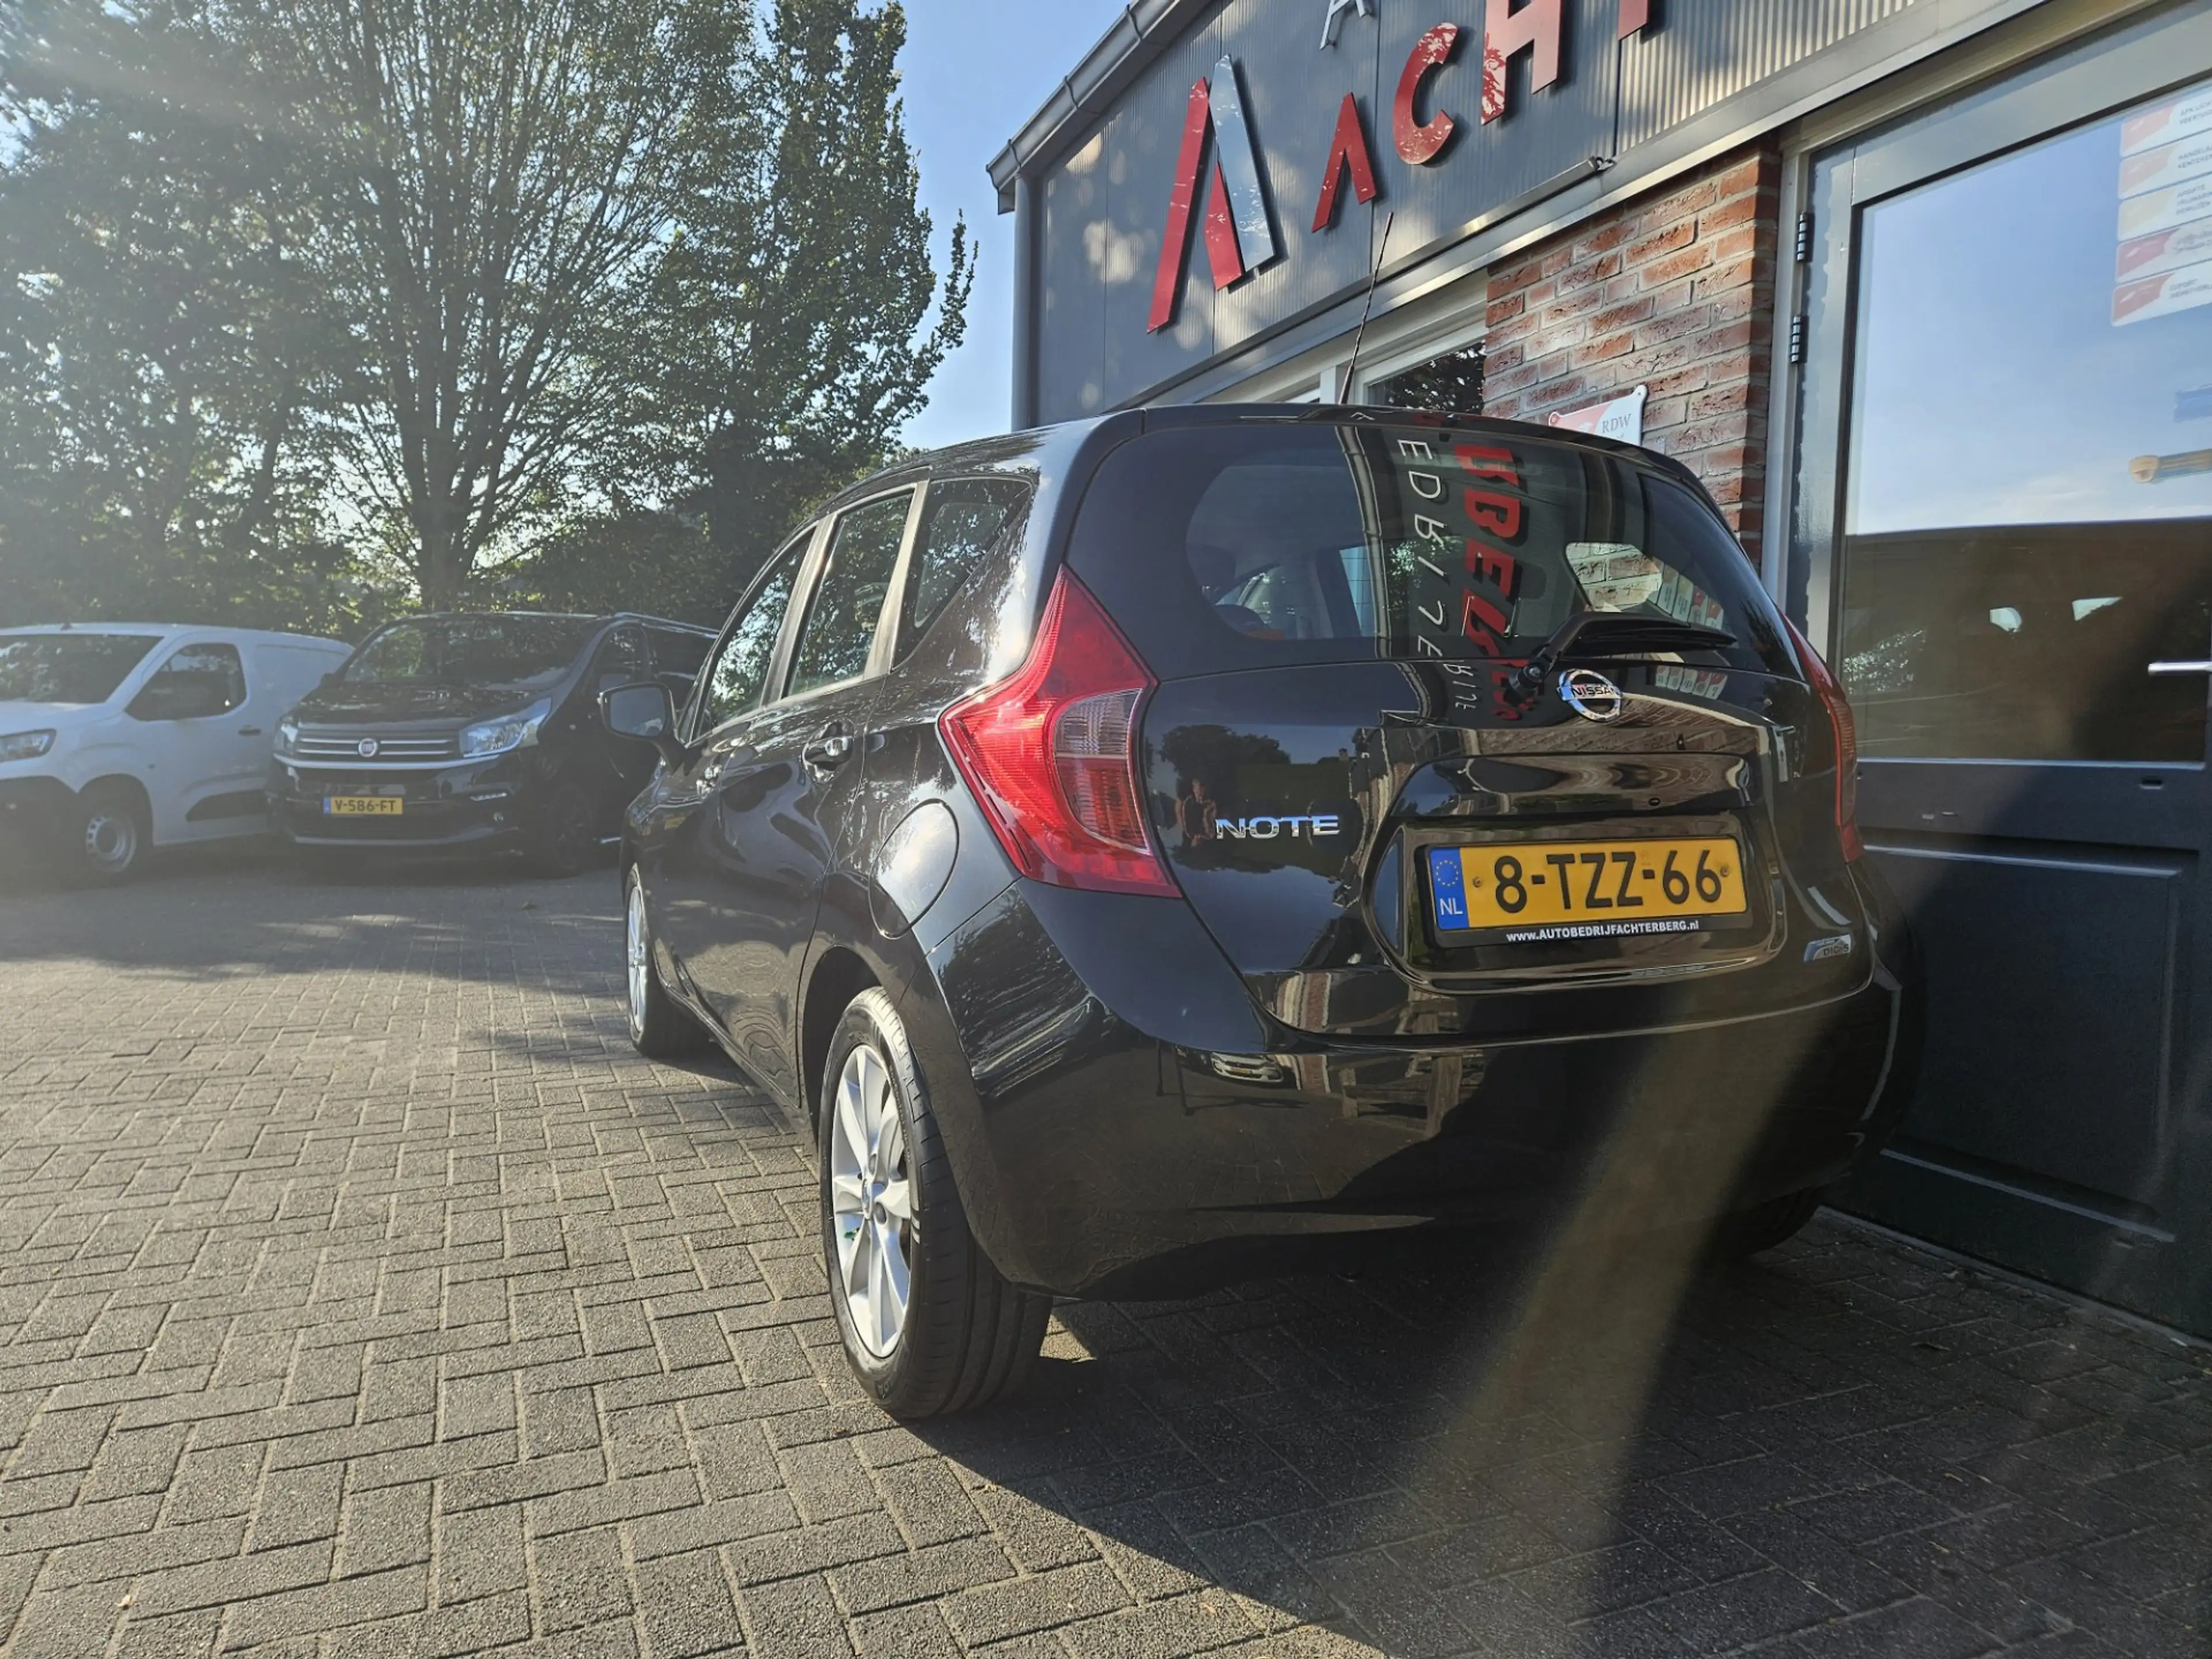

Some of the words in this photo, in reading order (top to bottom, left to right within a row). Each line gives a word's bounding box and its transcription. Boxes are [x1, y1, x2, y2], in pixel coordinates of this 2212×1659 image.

[1601, 413, 1631, 434] RDW
[335, 799, 396, 812] V-586-FT
[1215, 815, 1340, 840] NOTE
[1494, 849, 1722, 914] 8-TZZ-66
[1440, 897, 1463, 916] NL
[1506, 920, 1699, 942] www.AUTOBEDRIJFACHTERBERG.nl
